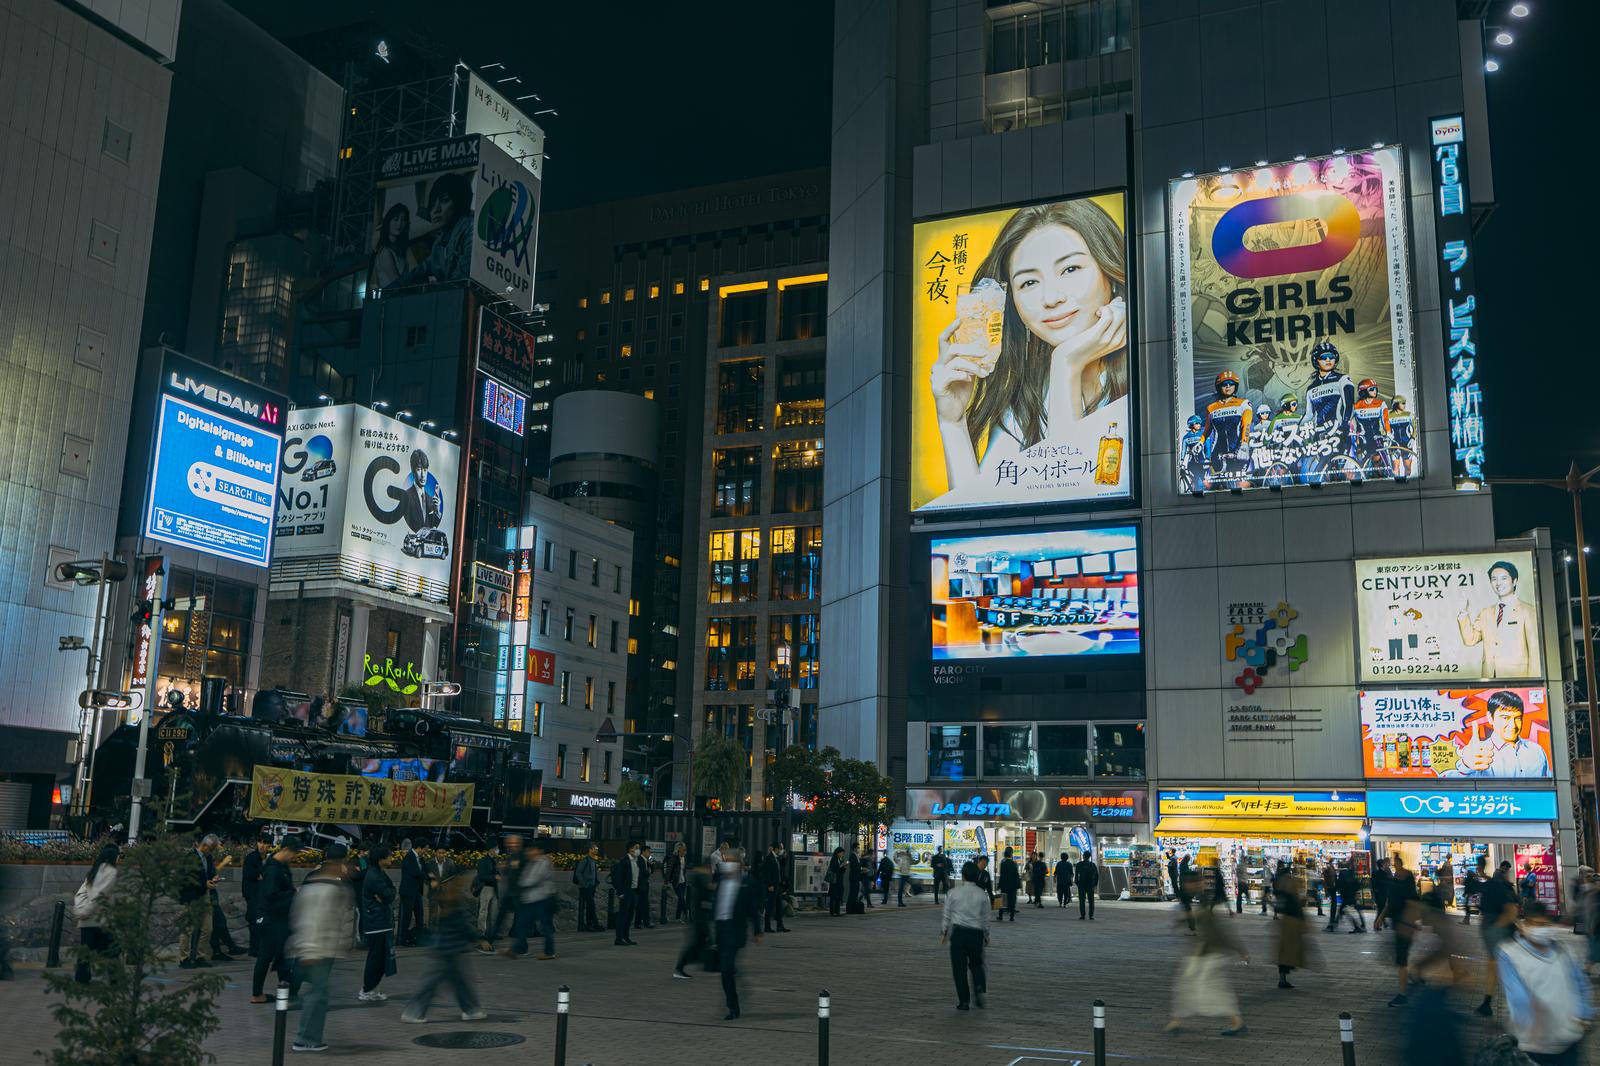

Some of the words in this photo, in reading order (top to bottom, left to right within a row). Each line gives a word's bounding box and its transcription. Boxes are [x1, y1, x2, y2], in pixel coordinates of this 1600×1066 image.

[1435, 127, 1461, 136] DyDo
[440, 140, 478, 160] MAX
[953, 233, 968, 275] 新橋で
[486, 255, 529, 293] GROUP
[925, 251, 951, 305] 今夜、
[1225, 275, 1353, 315] GIRLS
[1226, 308, 1355, 347] KEIRIN
[177, 410, 254, 448] Digitalsignage
[286, 423, 299, 432] AXI
[300, 421, 318, 431] GOes
[318, 420, 336, 429] Next.
[360, 428, 399, 441] 新橋のみなさん
[364, 440, 410, 453] 帰りは、どうする?
[214, 445, 223, 458] &
[226, 448, 272, 474] Billboard
[995, 459, 1100, 488] 角ハイボール
[218, 481, 253, 500] SEARCH
[279, 483, 329, 511] No.1
[1376, 562, 1462, 574] 東京のマンション経営は
[494, 573, 512, 589] MAX
[1361, 574, 1452, 591] CENTURY
[1458, 573, 1475, 587] 21
[1392, 590, 1444, 601] レイシャス
[1229, 607, 1264, 616] FARO
[1033, 613, 1096, 626] ミックスフロア
[1230, 616, 1264, 624] CITY
[933, 665, 963, 675] FARO
[965, 665, 986, 674] CITY
[1372, 663, 1460, 675] 0120-922-442
[933, 676, 964, 685] VISION
[1375, 697, 1441, 711] ダルい体に
[1375, 711, 1455, 723] スイッチ入れよう!
[172, 728, 185, 738] 292
[293, 776, 447, 810] 特殊詐欺根絶!!
[570, 794, 616, 809] McDonald's
[1231, 799, 1289, 812] マツモトキヨシ
[932, 803, 955, 815] LA
[1458, 803, 1521, 815] コンタクト
[893, 832, 934, 844] 8階個室
